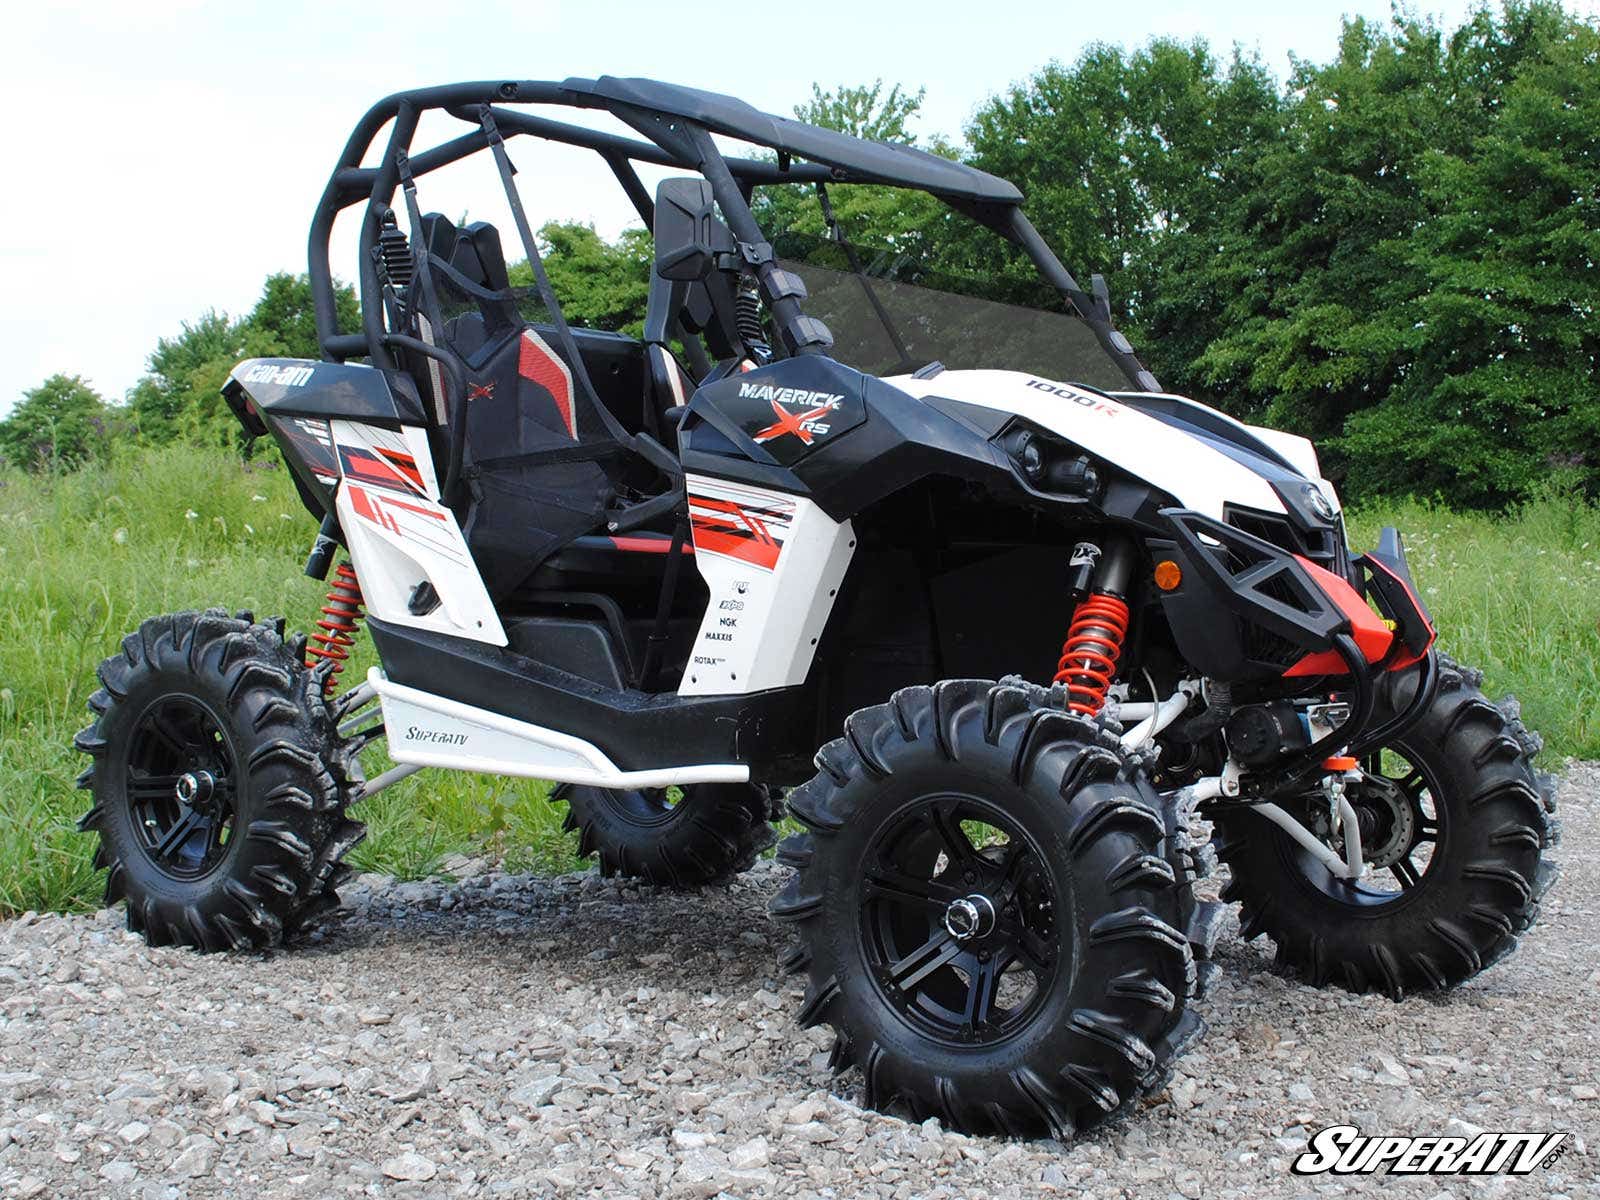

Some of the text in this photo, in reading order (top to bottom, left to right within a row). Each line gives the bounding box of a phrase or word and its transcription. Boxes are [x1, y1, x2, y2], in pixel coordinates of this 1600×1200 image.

[738, 383, 844, 410] MAVERICK
[1026, 379, 1119, 417] 1000R
[719, 617, 737, 627] NGK
[705, 632, 732, 641] MAXXIS
[694, 656, 717, 665] ROTAX
[405, 726, 469, 745] SUPERATV
